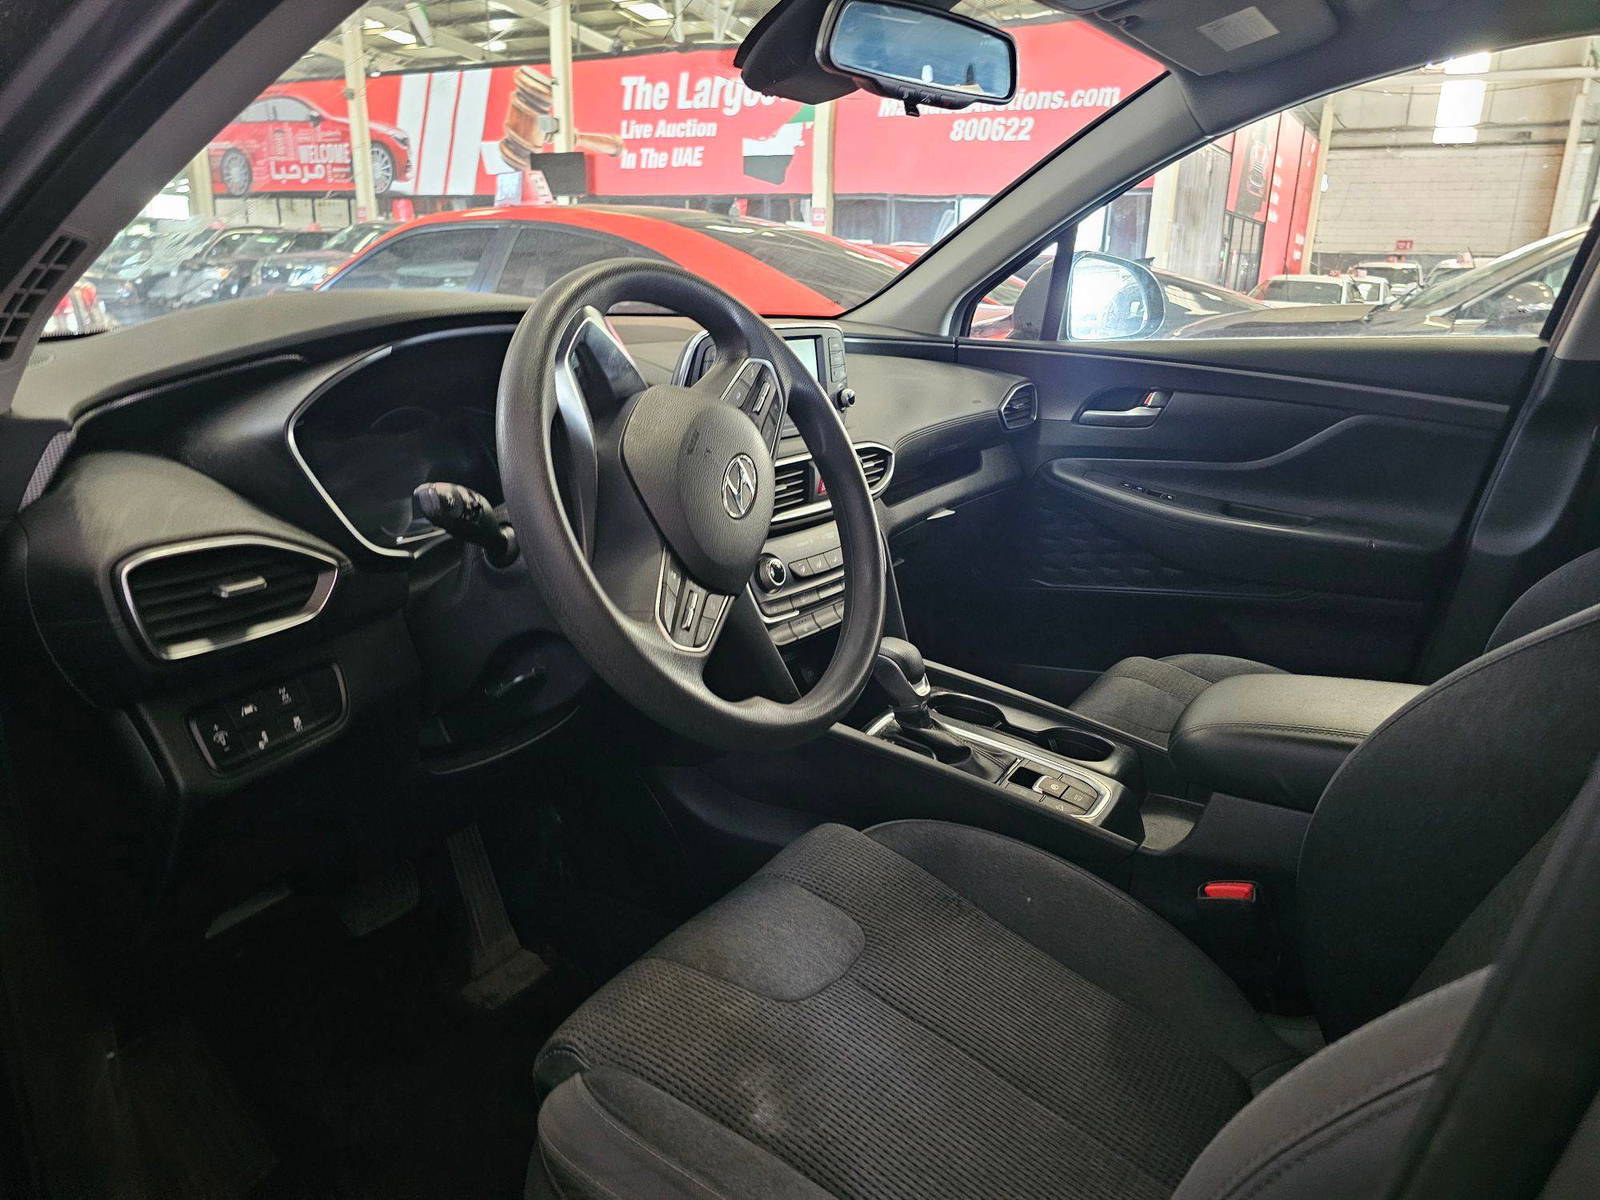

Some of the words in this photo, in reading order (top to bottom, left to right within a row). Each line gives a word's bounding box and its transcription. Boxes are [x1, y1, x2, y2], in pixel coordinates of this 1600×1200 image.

[620, 75, 670, 111] The
[677, 71, 787, 117] Large
[620, 119, 653, 139] Live
[655, 118, 718, 139] Auction
[949, 116, 1035, 142] 800622
[620, 149, 636, 169] In
[640, 147, 668, 169] The
[672, 146, 705, 168] UAE
[269, 160, 326, 184] مرحبا
